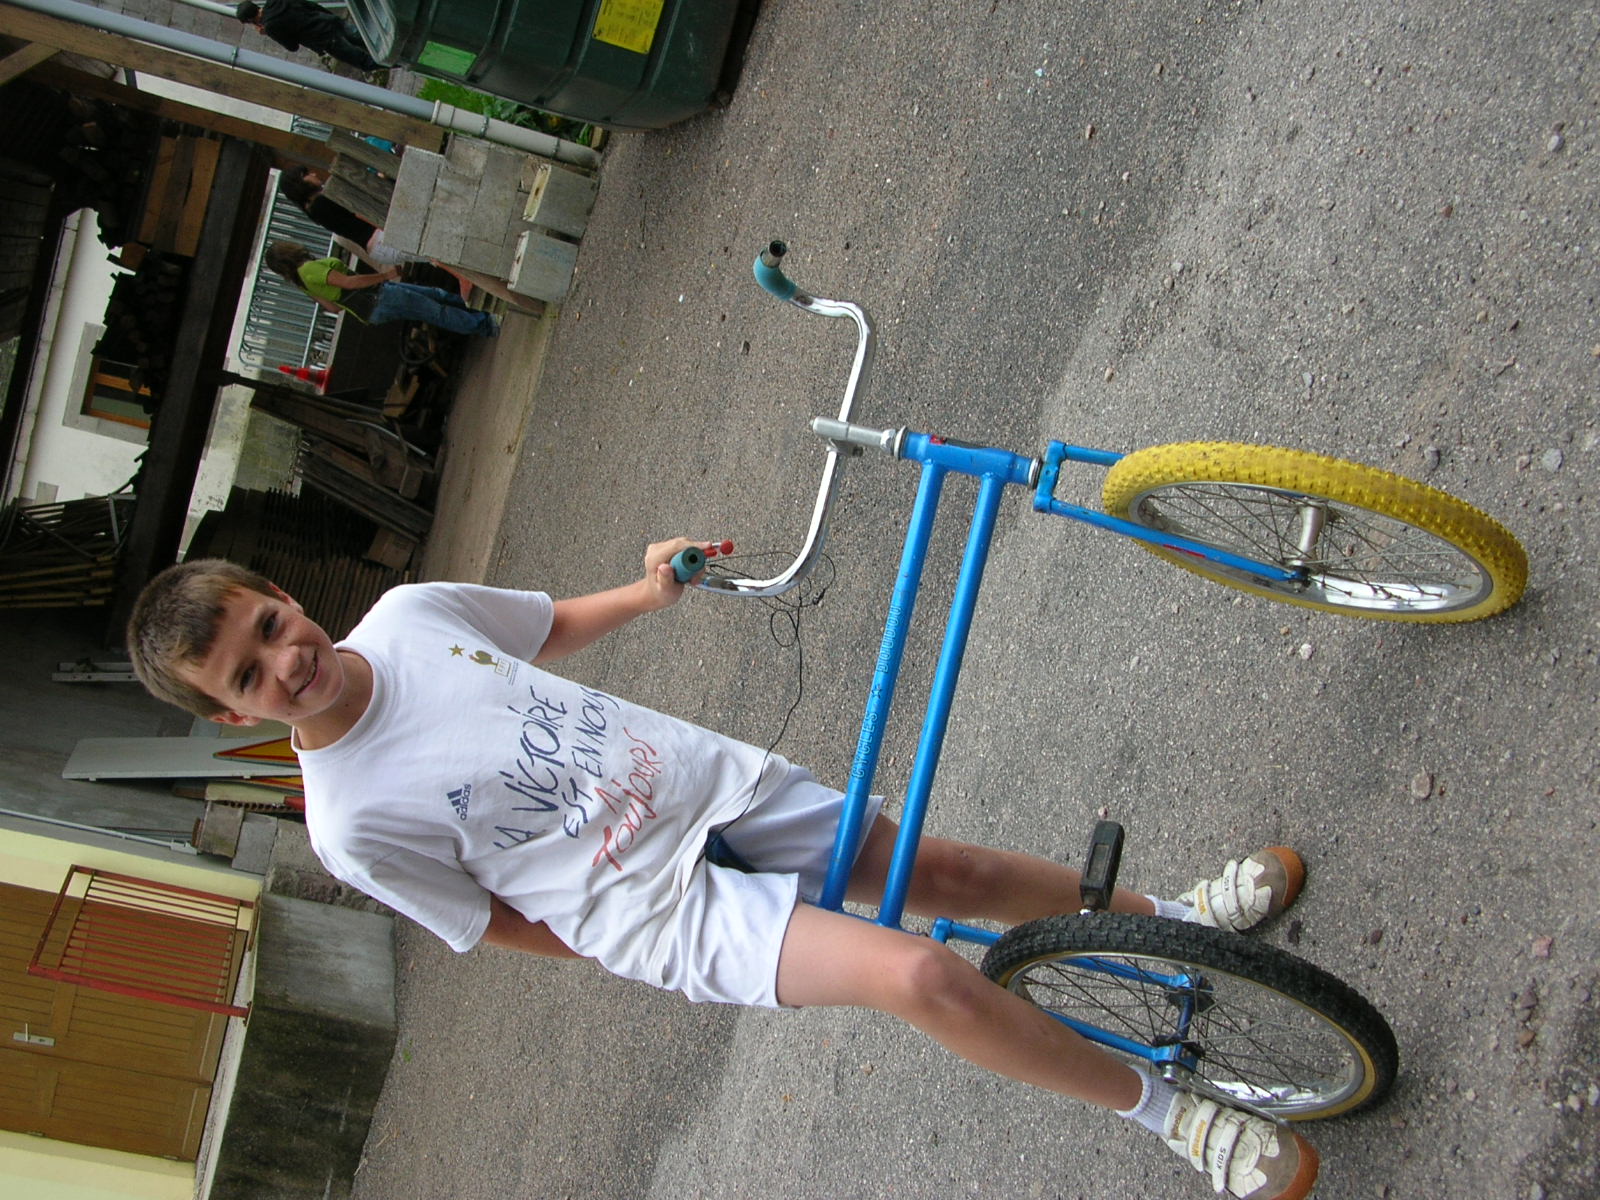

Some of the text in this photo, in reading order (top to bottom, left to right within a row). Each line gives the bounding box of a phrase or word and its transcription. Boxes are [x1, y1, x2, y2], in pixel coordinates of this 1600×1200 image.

[499, 685, 567, 812] VICTOIRE
[562, 686, 619, 838] EST EN NOUS
[852, 711, 877, 778] CYCLES
[460, 784, 472, 821] adidas
[1215, 1146, 1226, 1169] KIDS
